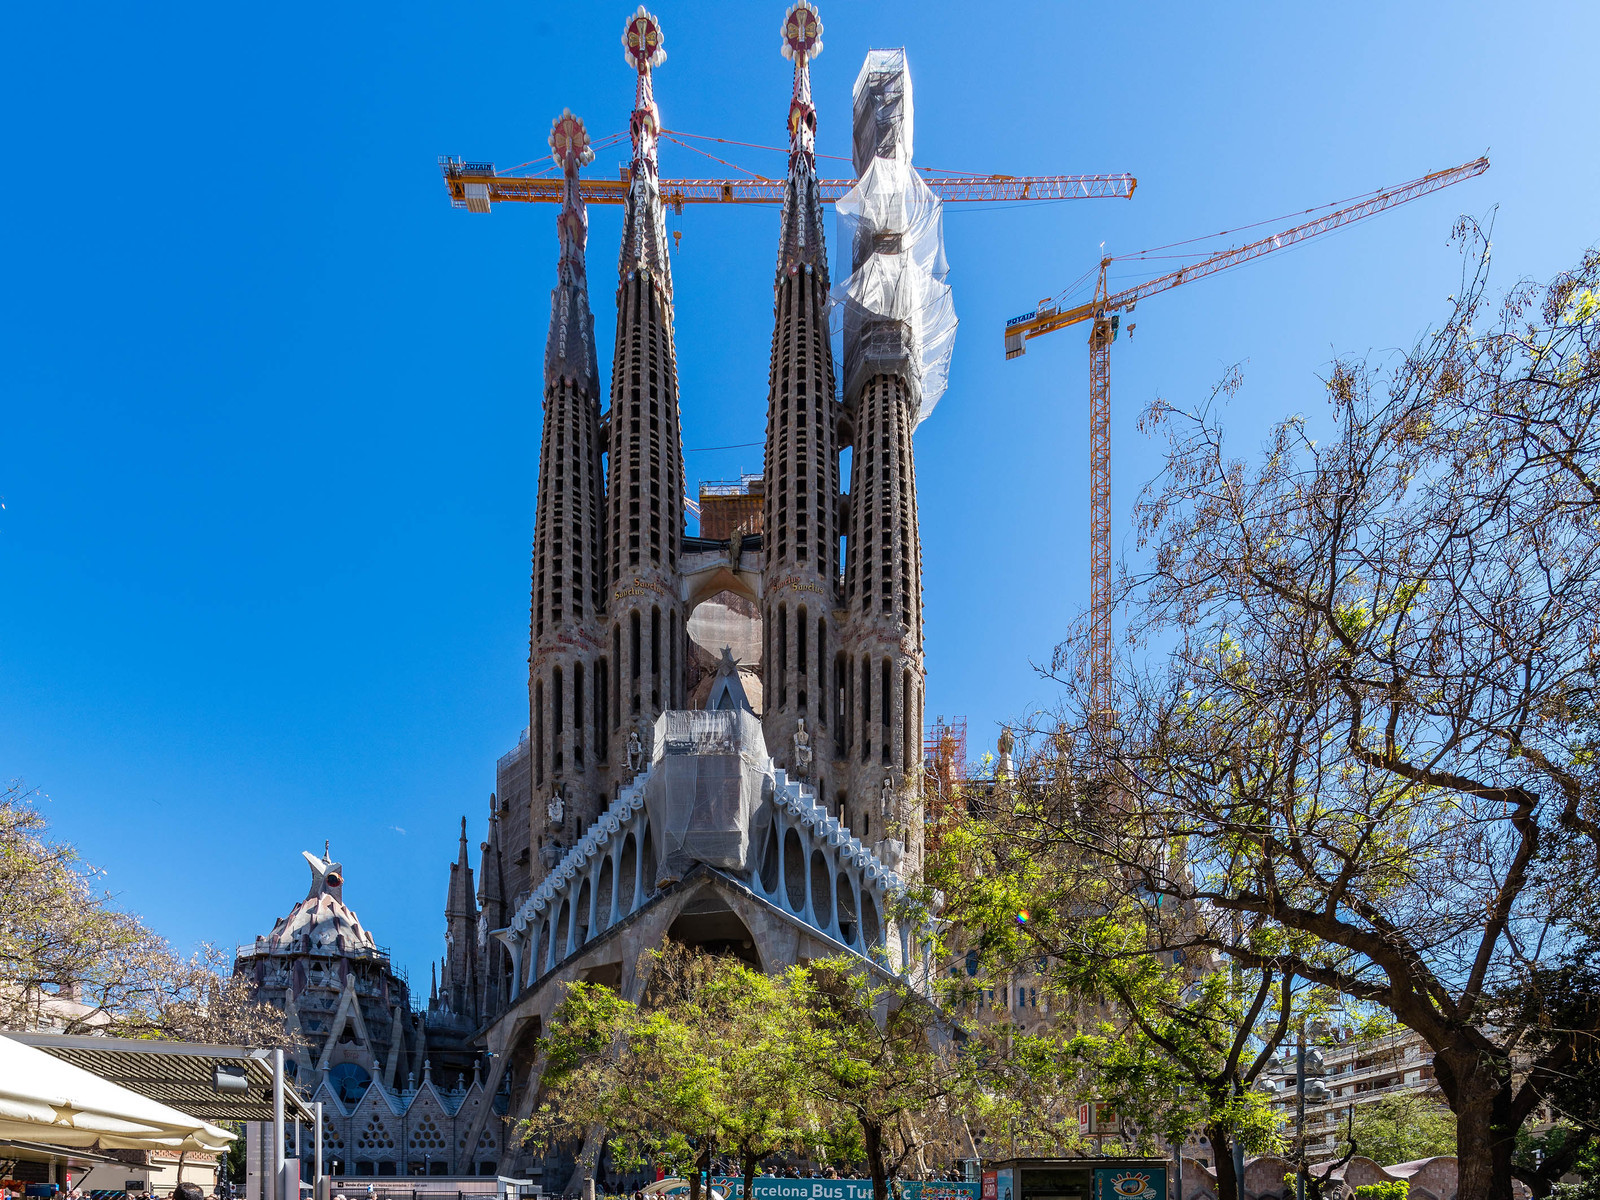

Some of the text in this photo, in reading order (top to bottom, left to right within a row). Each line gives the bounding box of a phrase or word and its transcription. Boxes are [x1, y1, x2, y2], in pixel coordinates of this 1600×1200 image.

[465, 163, 492, 171] POTAIN
[1006, 310, 1037, 327] POTAIN
[614, 587, 645, 600] Sanctus
[792, 583, 824, 595] Sanctus
[736, 1184, 911, 1200] Brcelona Bus Turc
